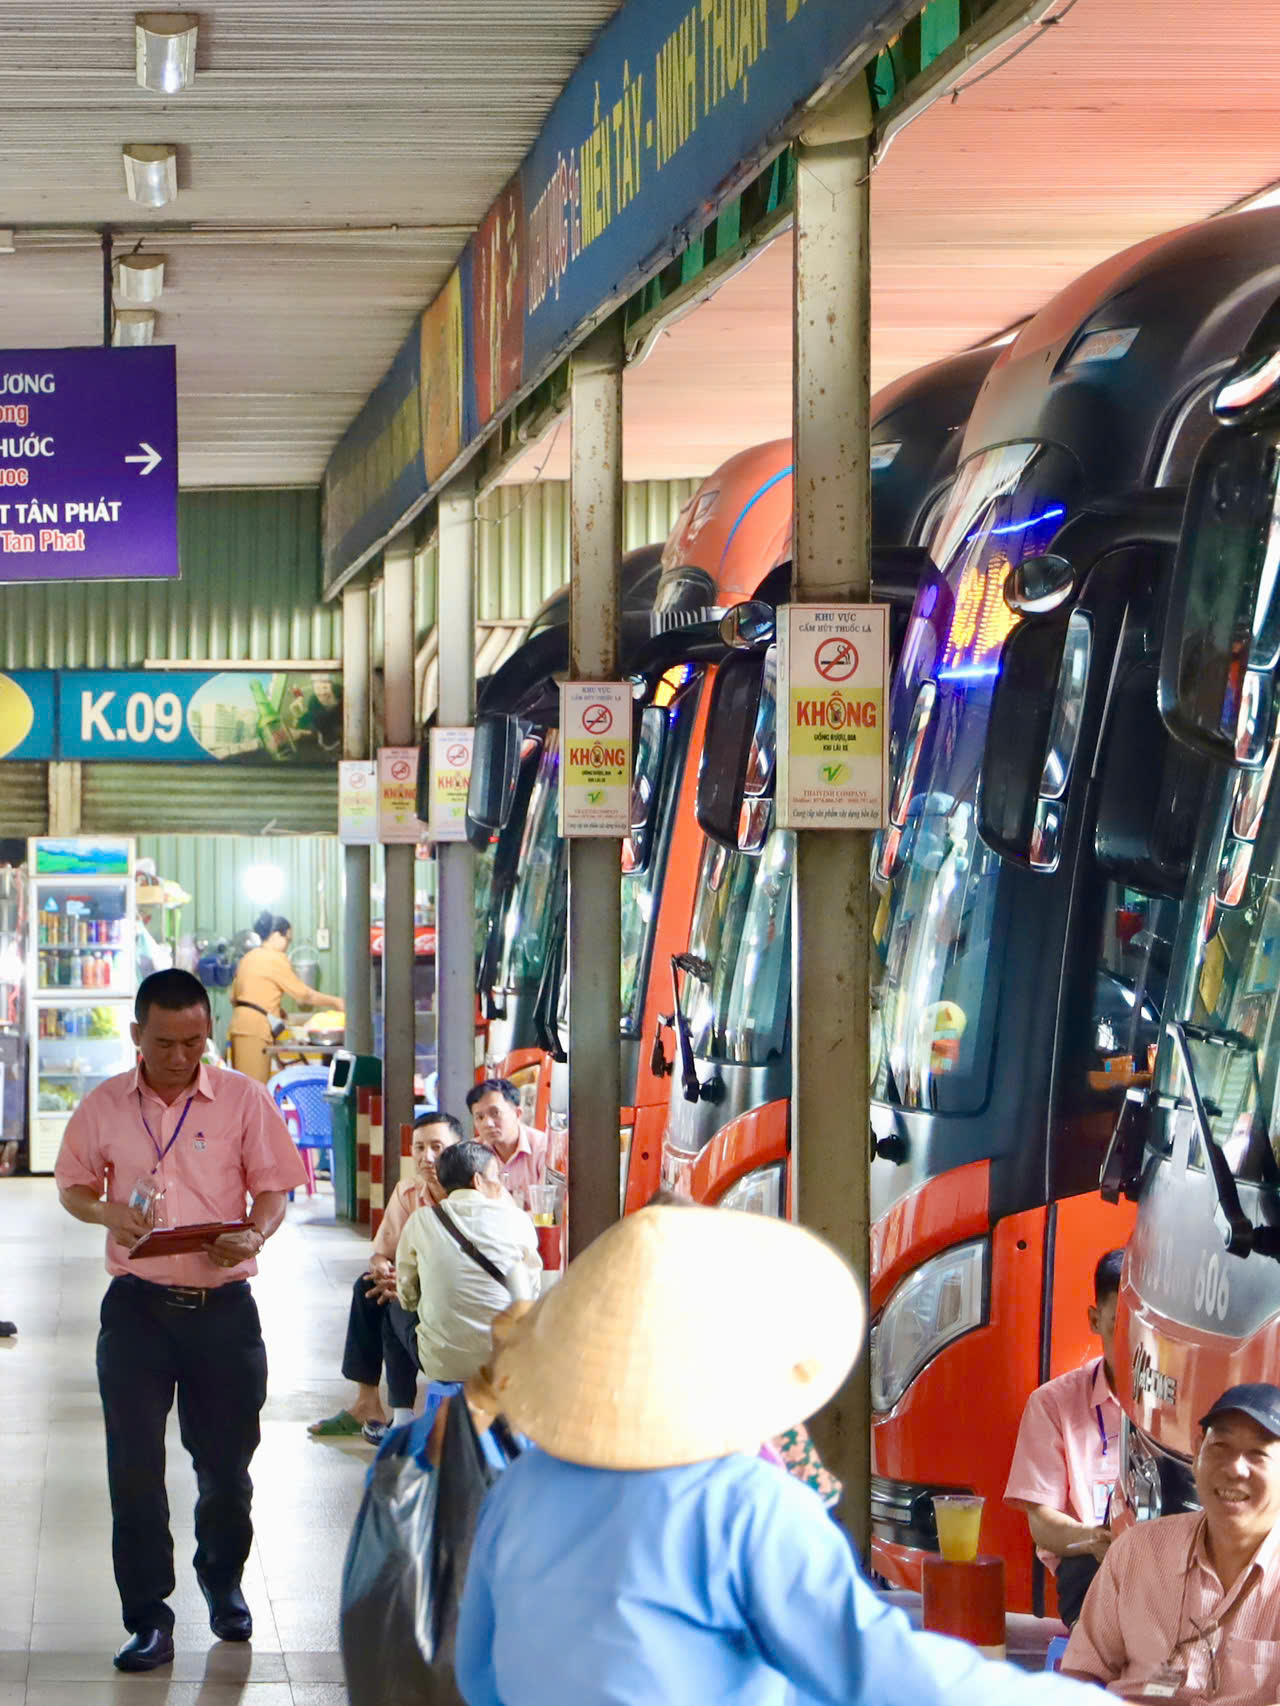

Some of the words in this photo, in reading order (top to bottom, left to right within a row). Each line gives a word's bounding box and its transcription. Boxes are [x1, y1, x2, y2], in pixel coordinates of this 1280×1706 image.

[613, 58, 643, 215] TÂY
[656, 6, 697, 172] NINH
[16, 499, 59, 524] TÂN
[64, 496, 122, 524] PHÁT
[0, 530, 35, 553] Tan
[40, 529, 85, 553] Phat
[814, 613, 835, 622] KHU
[838, 612, 857, 623] VỰC
[80, 690, 184, 743] K.09
[796, 690, 877, 731] KHÔNG
[569, 740, 625, 768] KHÔNG
[437, 773, 472, 792] KHÔN
